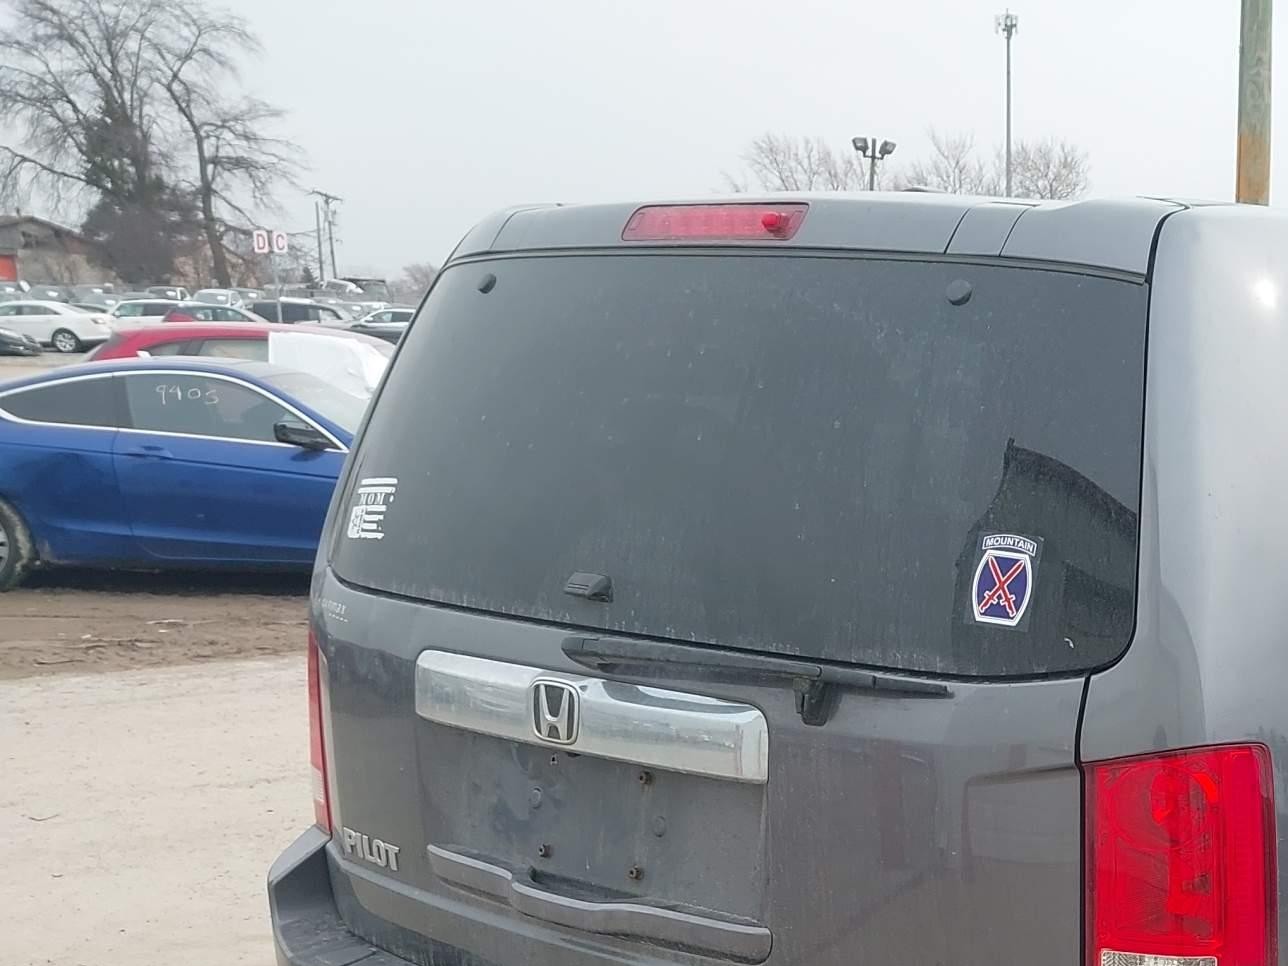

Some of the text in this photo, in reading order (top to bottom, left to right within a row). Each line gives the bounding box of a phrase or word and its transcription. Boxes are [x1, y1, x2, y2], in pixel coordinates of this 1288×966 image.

[256, 233, 266, 250] D
[275, 233, 286, 251] C
[985, 536, 1035, 552] MOUNTAIN
[342, 826, 400, 871] PILOT
